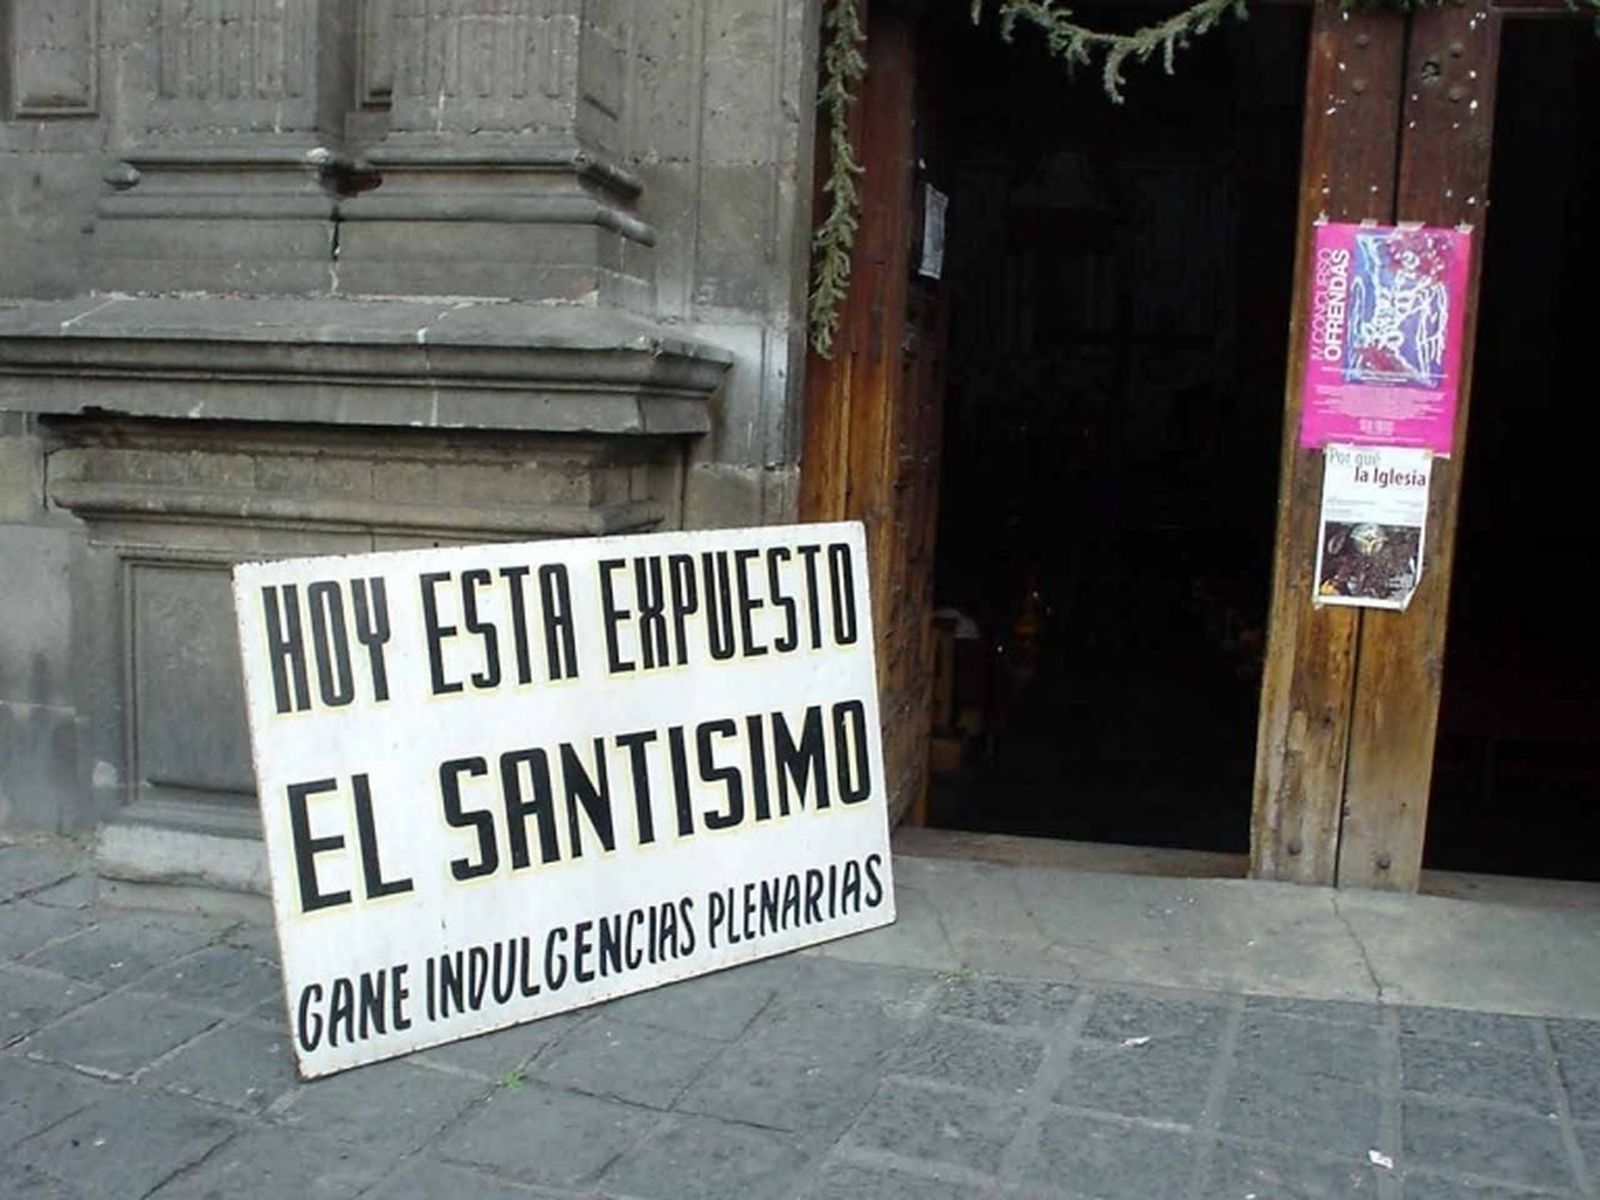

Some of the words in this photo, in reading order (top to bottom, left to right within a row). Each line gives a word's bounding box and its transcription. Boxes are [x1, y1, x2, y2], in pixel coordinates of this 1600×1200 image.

[1312, 247, 1332, 344] CONCURSO
[1324, 249, 1350, 362] OFRENDAS
[1329, 447, 1350, 464] Por
[1354, 466, 1369, 482] la
[1373, 467, 1427, 488] Iglesia
[262, 577, 391, 714] HOY
[421, 563, 579, 695] ESTA
[599, 542, 857, 674] EXPUESTO
[287, 773, 413, 912] EL
[440, 699, 871, 881] SANTISIMO
[298, 964, 411, 1052] GANE
[426, 897, 695, 1022] INDULGENCIAS
[708, 853, 884, 949] PLENARIAS
